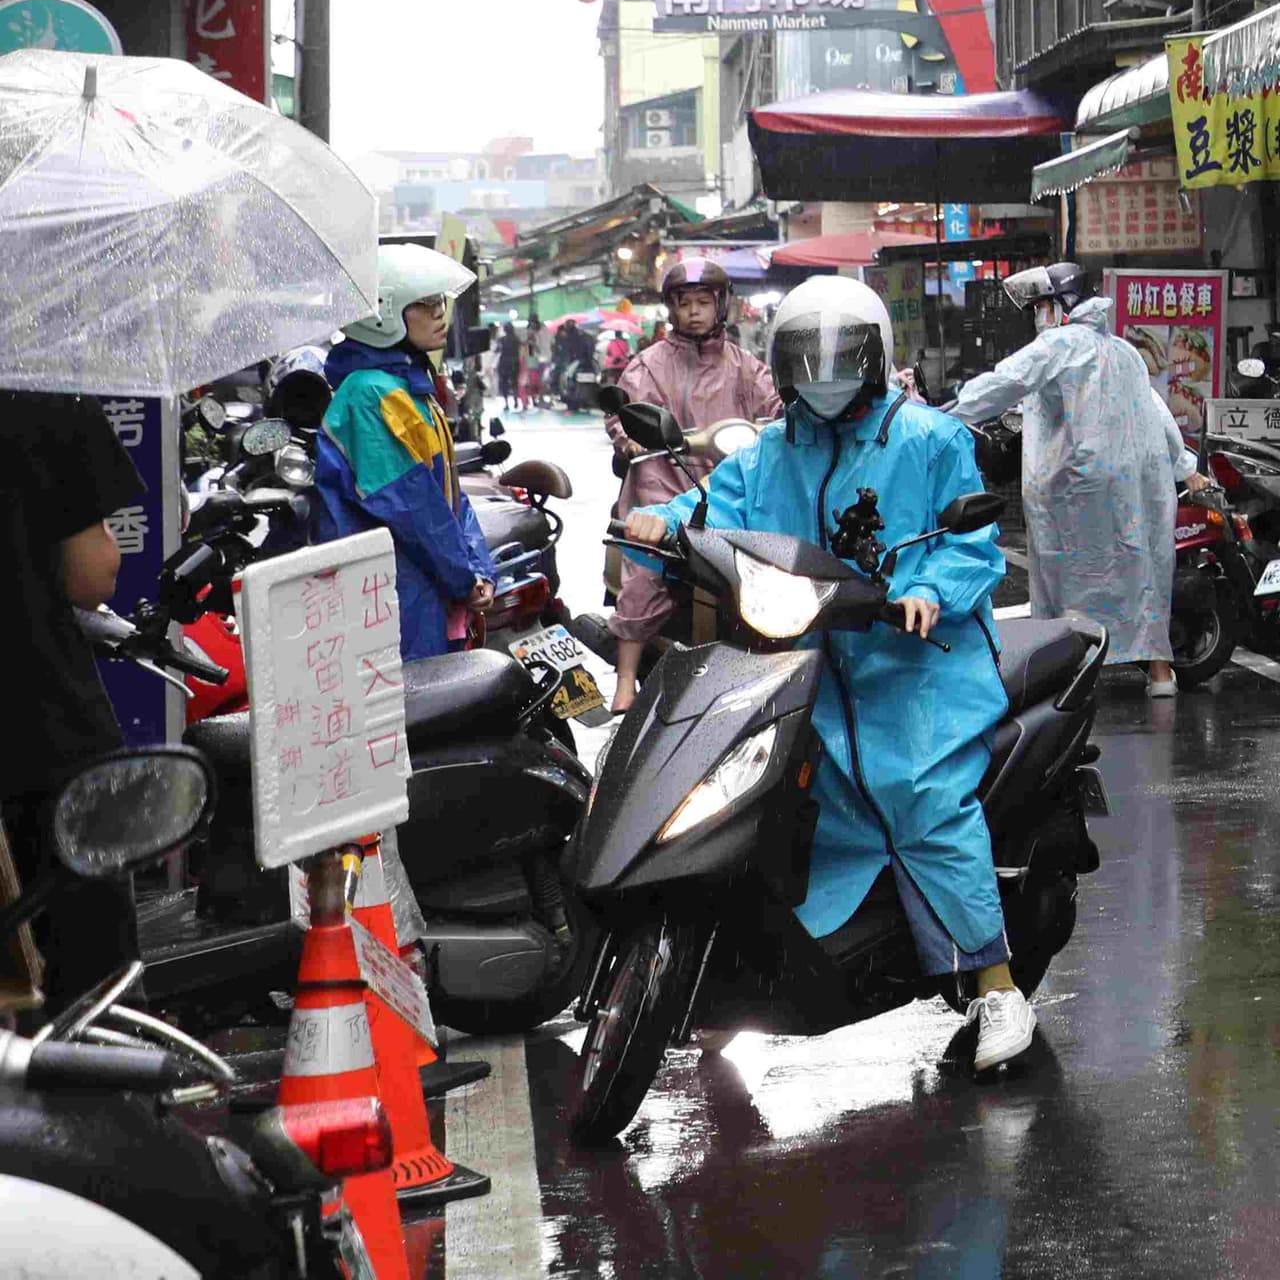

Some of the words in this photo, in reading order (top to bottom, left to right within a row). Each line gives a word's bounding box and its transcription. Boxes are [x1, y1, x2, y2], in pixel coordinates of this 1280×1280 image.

[706, 15, 768, 30] Nanmen
[772, 15, 827, 30] Market
[1126, 281, 1213, 318] 粉紅色餐車
[301, 573, 362, 807] 請留通道
[360, 572, 402, 770] 出入口
